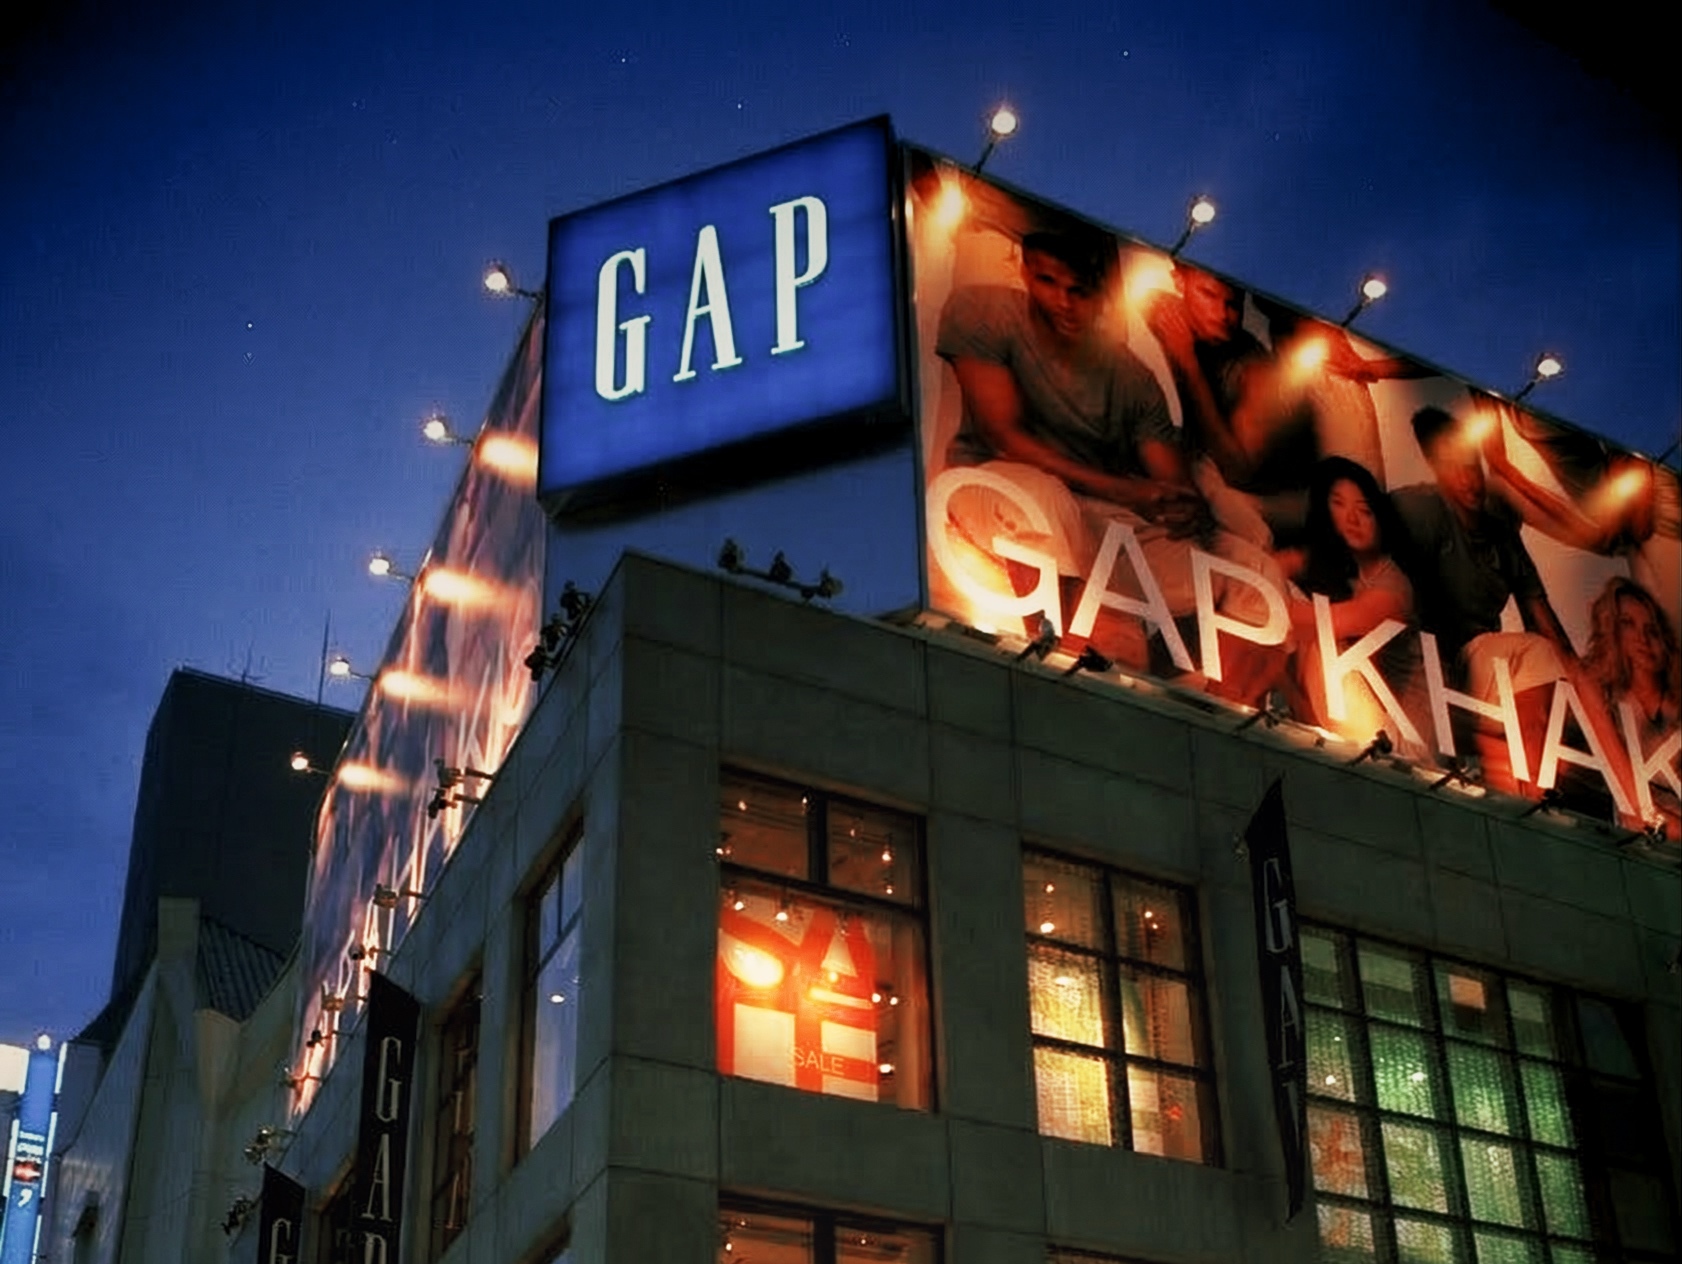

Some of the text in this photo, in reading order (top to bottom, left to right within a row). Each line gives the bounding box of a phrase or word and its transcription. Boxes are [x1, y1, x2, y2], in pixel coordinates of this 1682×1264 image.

[595, 195, 828, 402] GAP
[926, 465, 1291, 684] GAP
[790, 1046, 845, 1076] SALE
